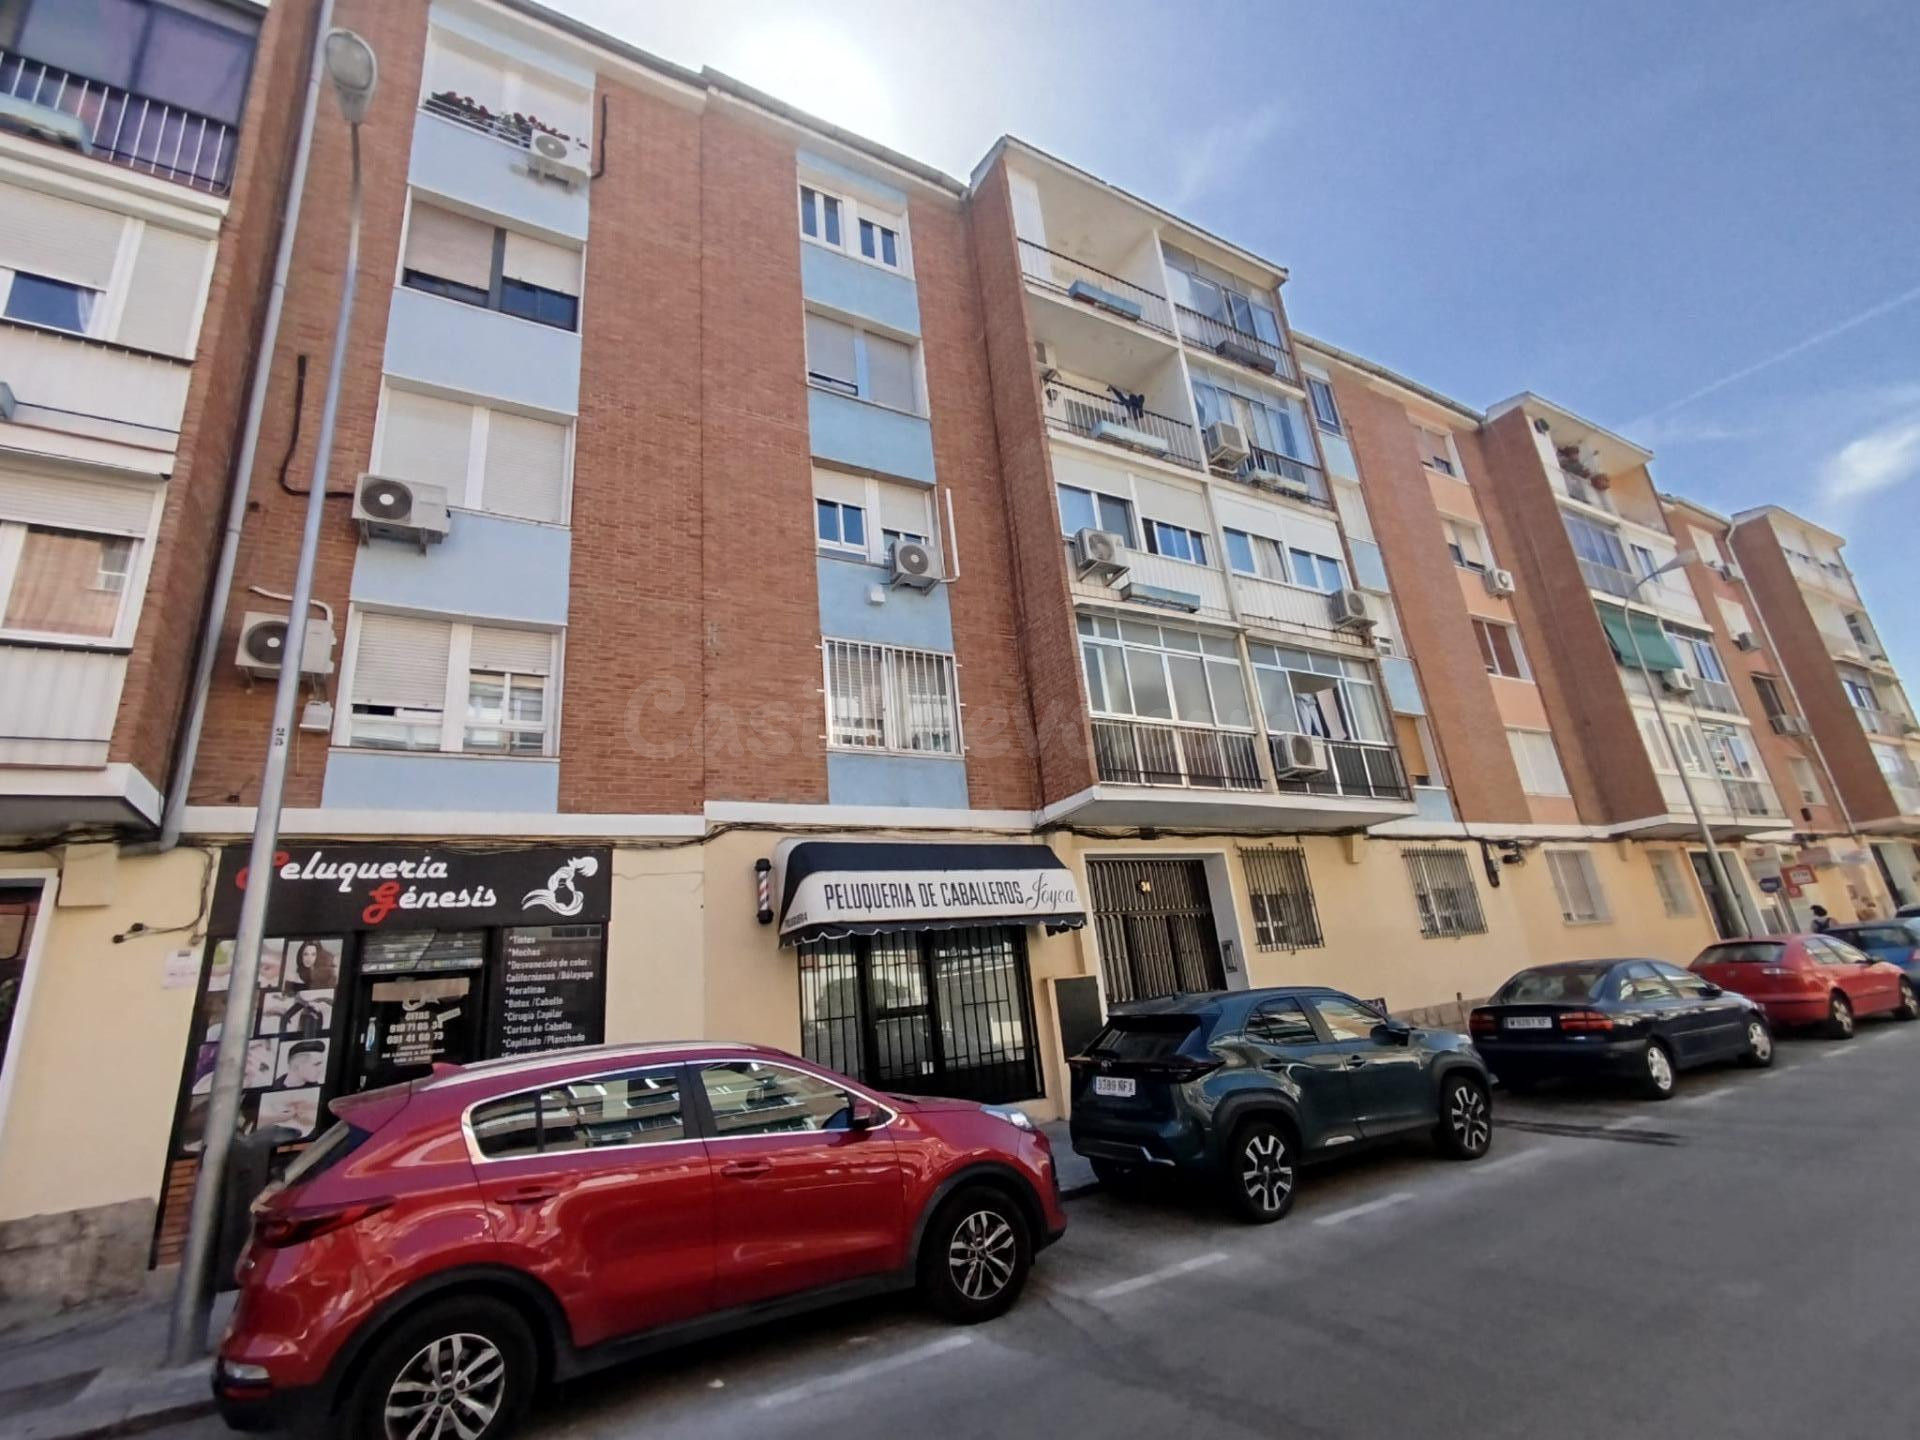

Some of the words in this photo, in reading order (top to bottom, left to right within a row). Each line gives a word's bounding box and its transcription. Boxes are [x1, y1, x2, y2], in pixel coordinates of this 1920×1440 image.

[362, 880, 497, 924] Génesis
[823, 883, 916, 913] PELUQUERIA
[919, 882, 938, 907] DE
[940, 881, 1024, 907] CABALLEROS
